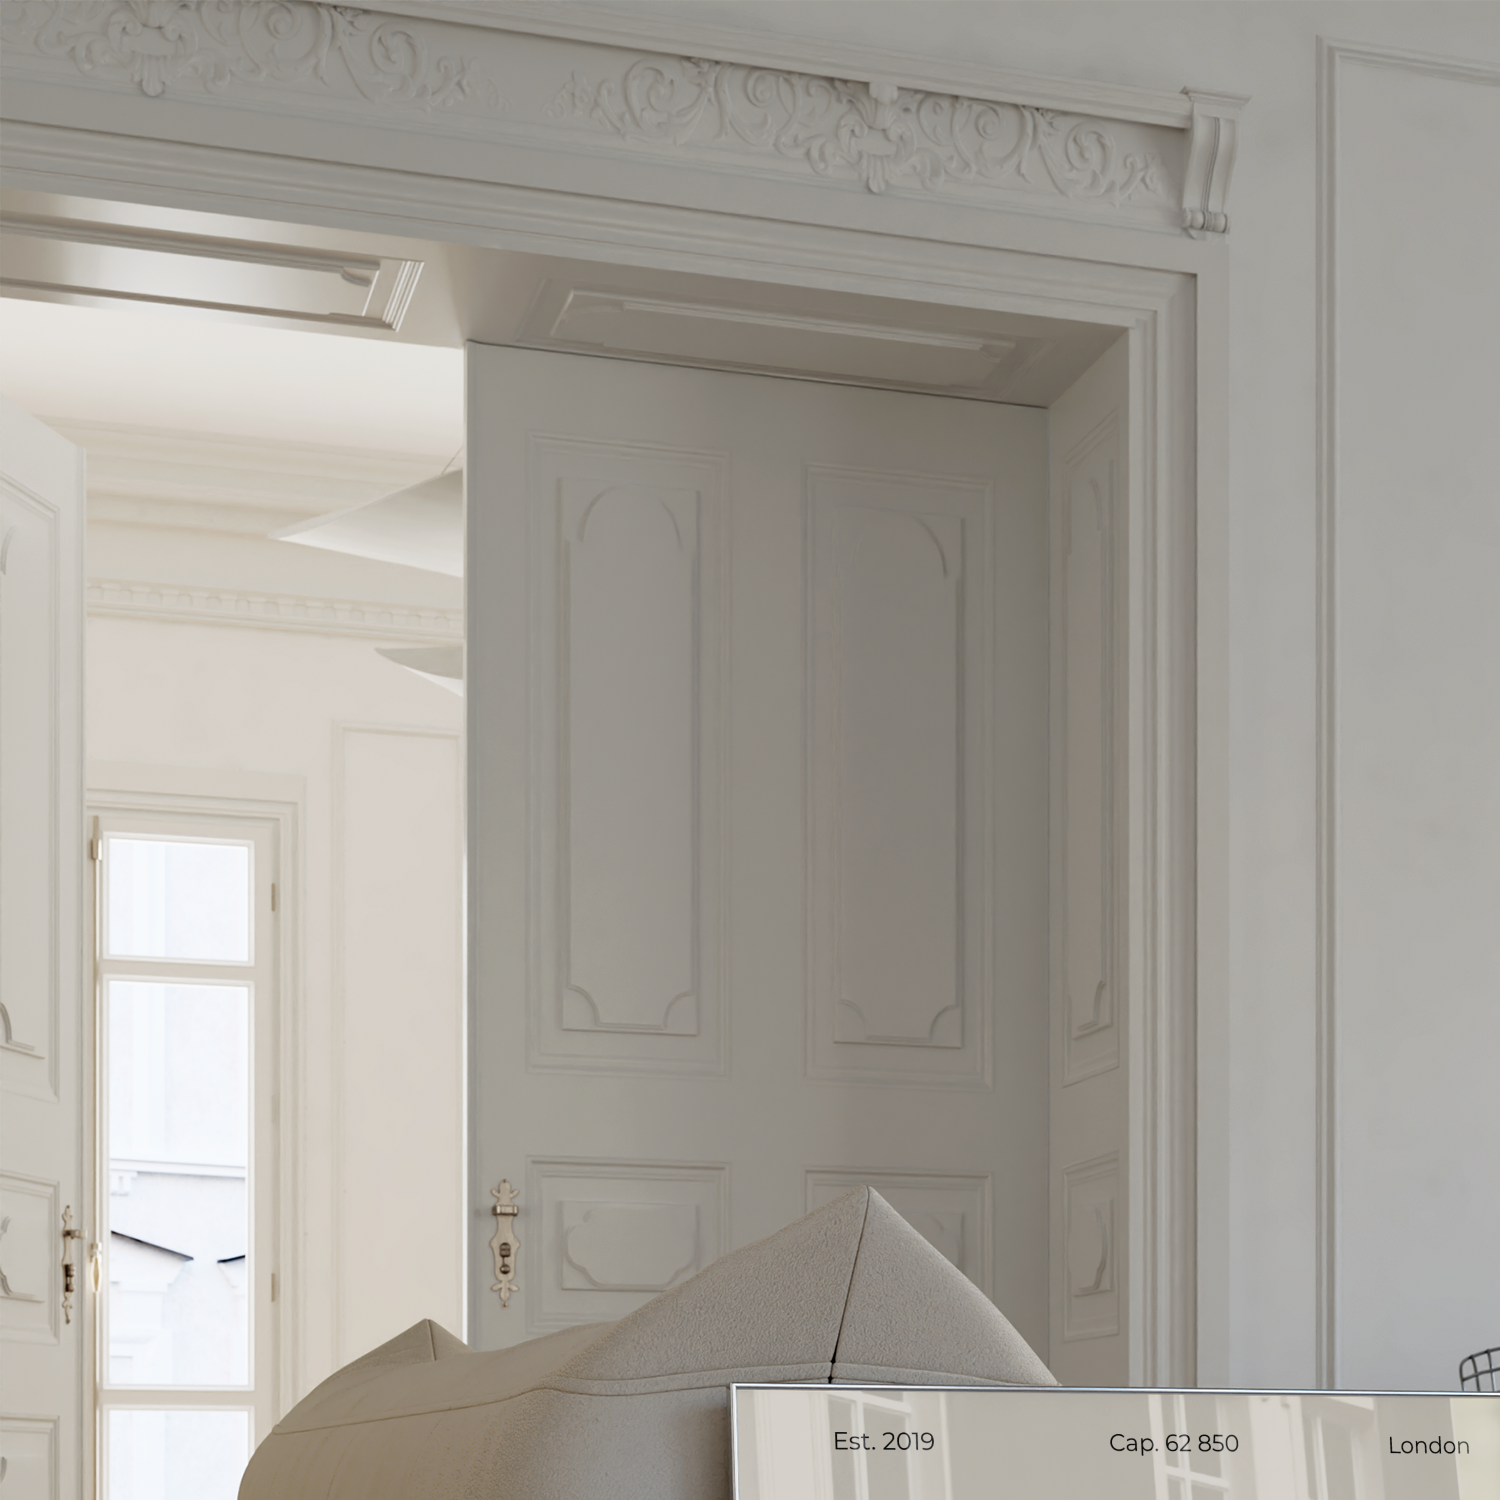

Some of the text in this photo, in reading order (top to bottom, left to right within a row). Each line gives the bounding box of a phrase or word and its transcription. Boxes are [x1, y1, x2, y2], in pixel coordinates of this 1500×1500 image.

[833, 1431, 935, 1451] Est. 2019
[1109, 1433, 1240, 1457] Cap. 62 850
[1389, 1435, 1470, 1455] London
